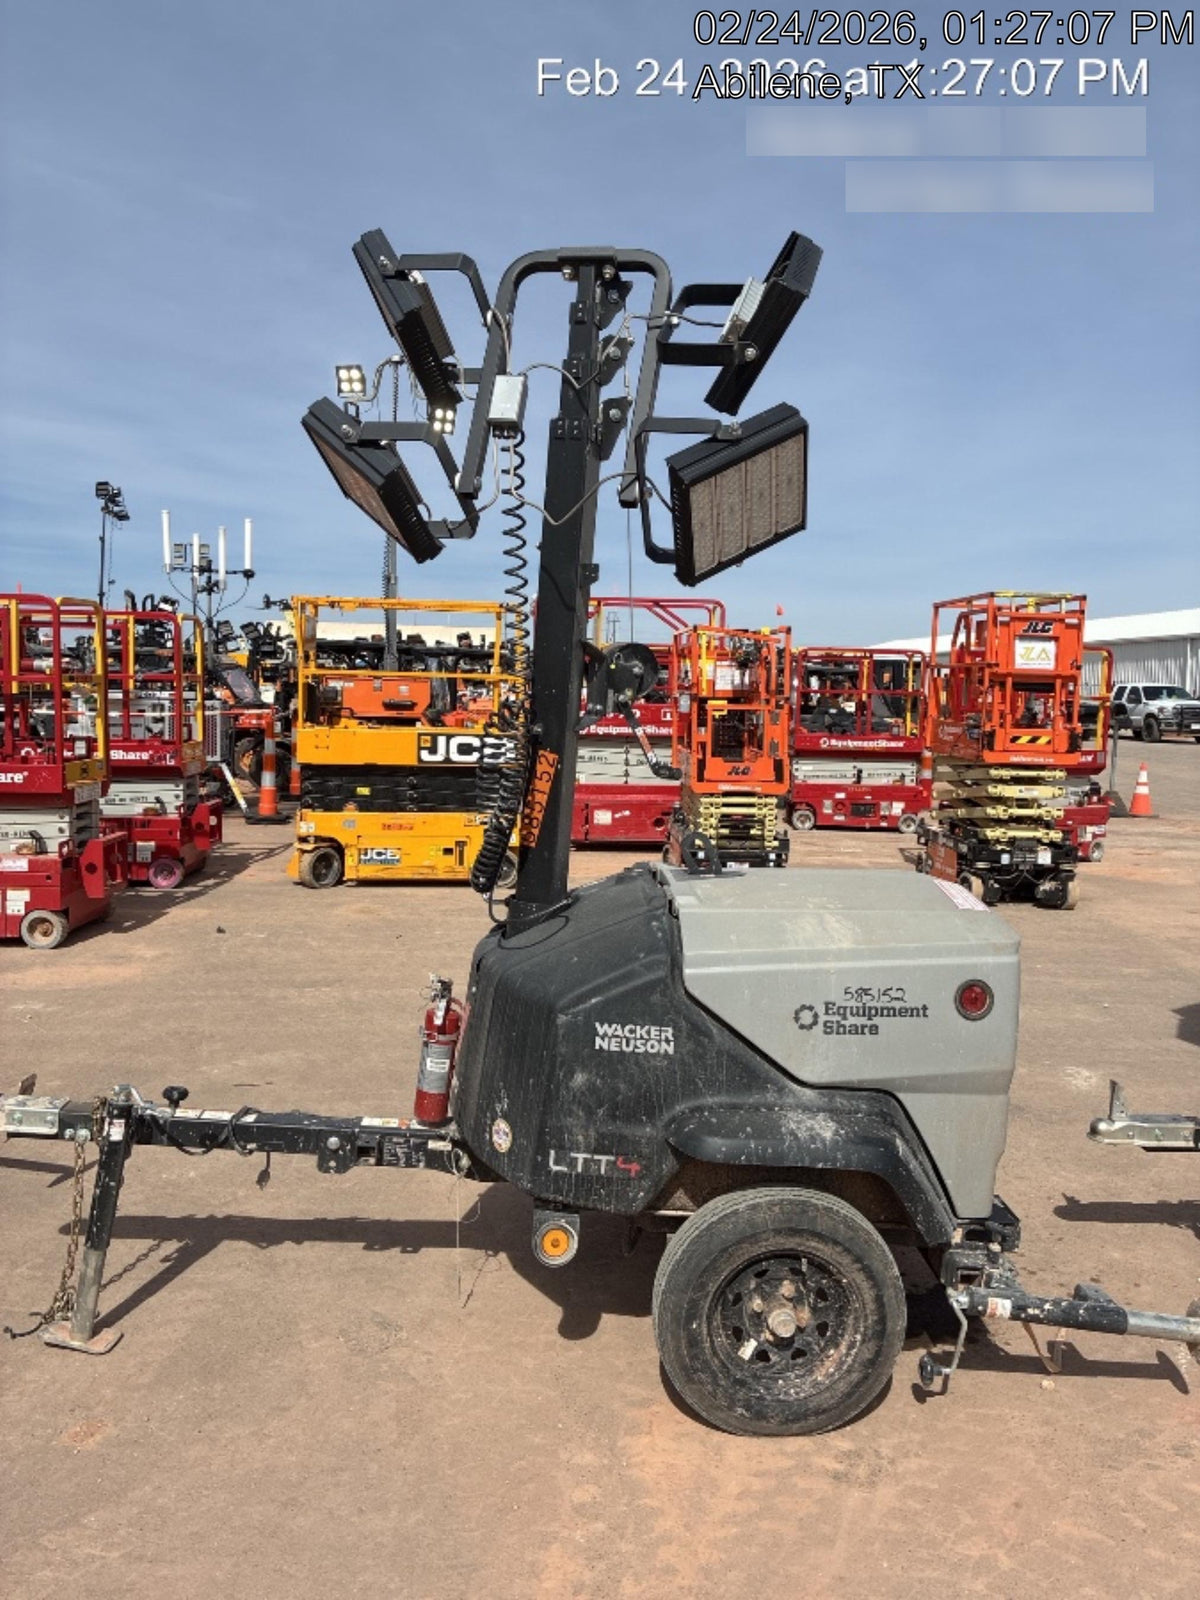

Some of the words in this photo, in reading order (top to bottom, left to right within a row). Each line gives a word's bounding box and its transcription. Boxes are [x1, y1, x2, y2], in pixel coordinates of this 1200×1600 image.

[1022, 622, 1053, 634] JLG
[110, 749, 150, 760] Share
[844, 987, 907, 1003] 585152
[823, 1002, 929, 1021] Equipment
[595, 1022, 674, 1041] WACKER
[823, 1020, 879, 1035] Share
[595, 1036, 674, 1055] NEUSON
